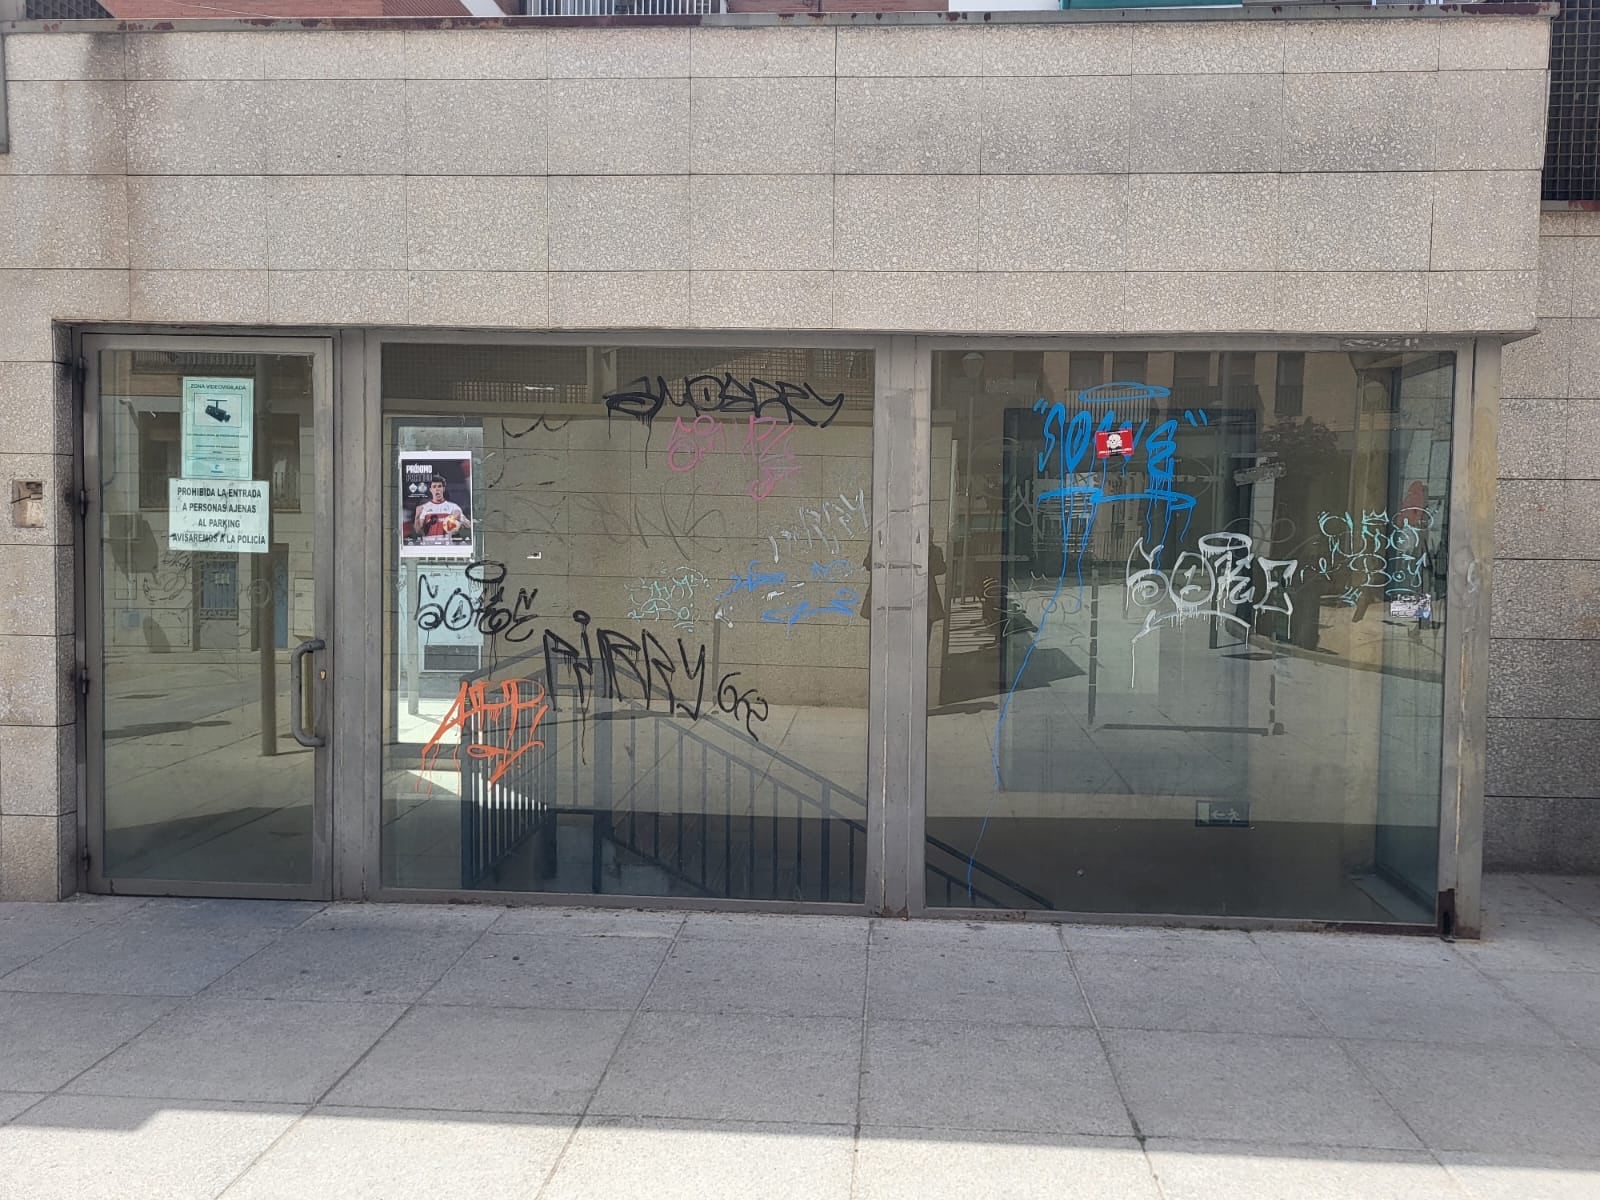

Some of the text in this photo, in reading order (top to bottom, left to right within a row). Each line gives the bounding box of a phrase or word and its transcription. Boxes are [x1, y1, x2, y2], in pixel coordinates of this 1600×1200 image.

[177, 487, 262, 498] PROHIBIDA LA ENTRADA
[182, 503, 257, 513] A PERSONAS AJENAS
[198, 518, 241, 528] AL PARKING
[172, 532, 218, 543] AVISAREMOS
[226, 535, 236, 544] LA
